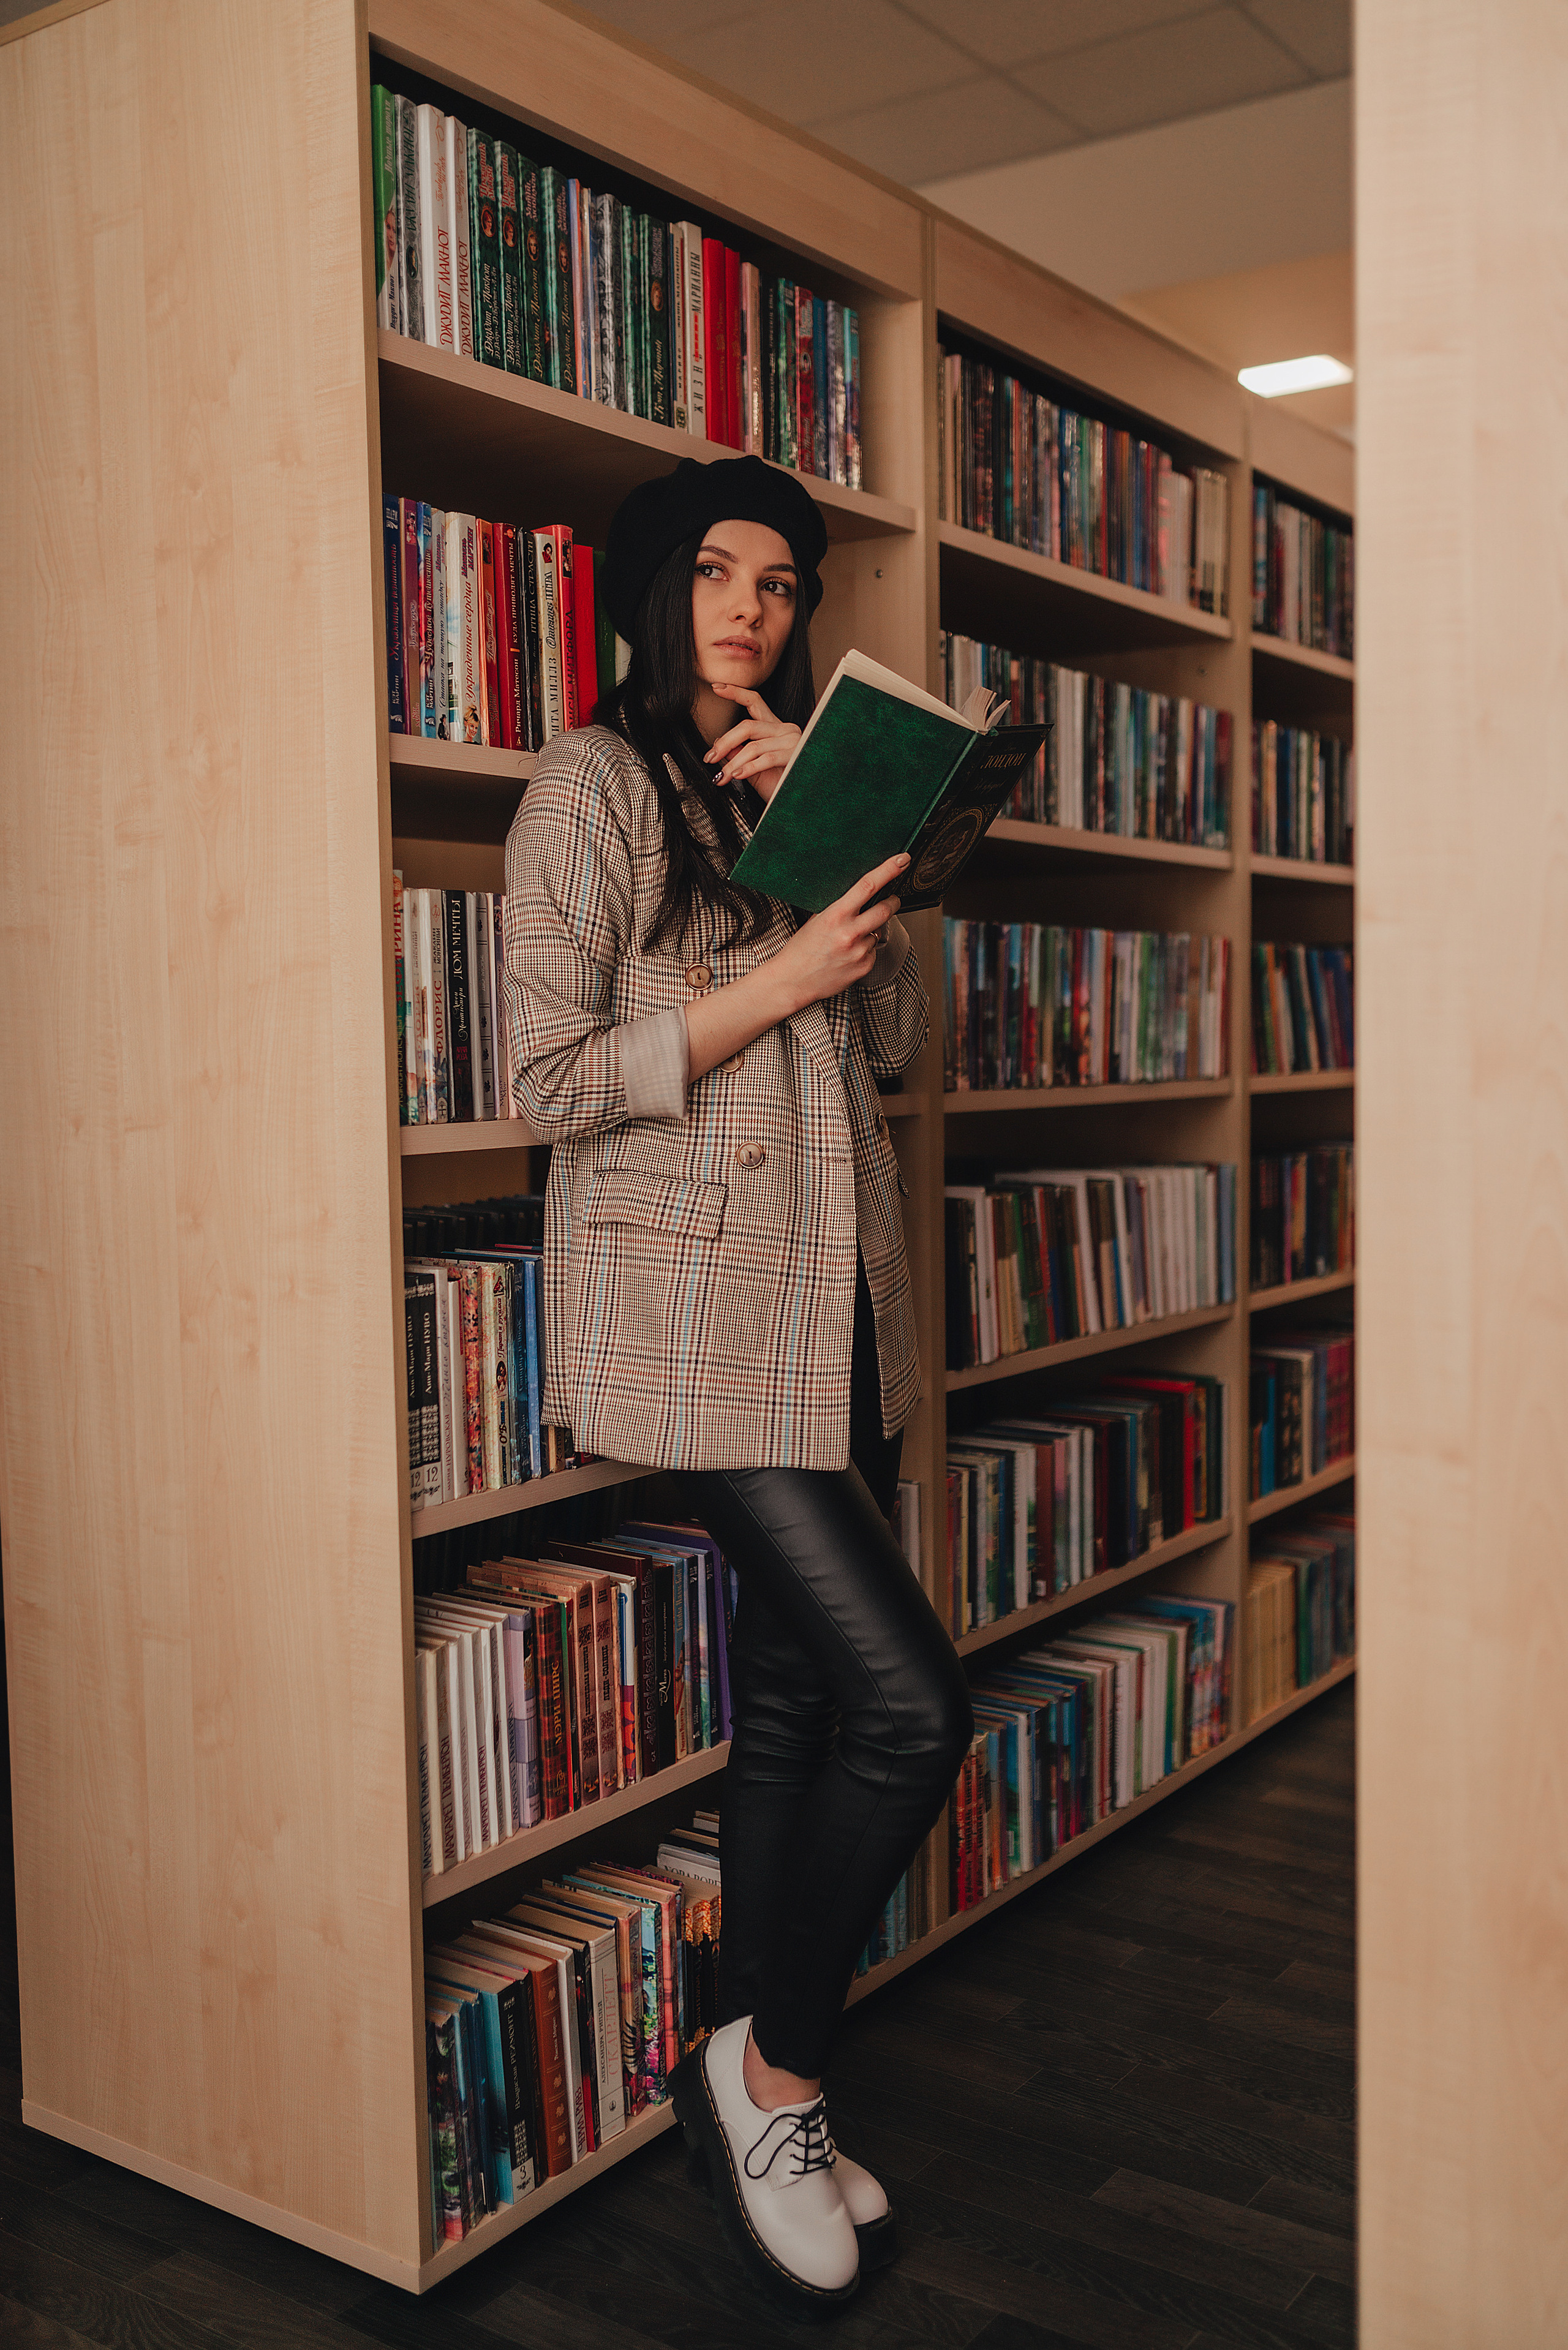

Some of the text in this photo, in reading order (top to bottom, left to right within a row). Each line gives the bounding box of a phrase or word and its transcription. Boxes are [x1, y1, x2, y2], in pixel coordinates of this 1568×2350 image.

[385, 136, 394, 181] Ночные
[478, 142, 489, 197] Праздник
[501, 154, 510, 208] Праздник
[438, 226, 453, 345] ДЖУДИТ МАКНОТ
[458, 238, 472, 355] ДЖУДИТ МАКНОТ
[483, 263, 494, 356] Джудит Макнот
[690, 252, 701, 314] МАРИАННЫ
[505, 273, 515, 365] Джудит Макнот
[531, 268, 543, 378] Джудит Макнот
[561, 280, 574, 388] Джудит Макнот
[654, 339, 665, 420] Кэт Мартин
[424, 550, 434, 662] Чудесное путешествие
[545, 571, 553, 600] ИГРА
[390, 600, 401, 661] Украденная
[440, 657, 445, 668] на
[463, 581, 476, 702] Украденные сердца
[565, 609, 575, 685] МИТФОРД
[548, 658, 558, 702] МИЛЛЗ
[981, 753, 1027, 769] ЛОНДОН
[394, 901, 404, 1007] ЗЕФИРИНА
[451, 899, 462, 979] ДОМ МЕЧТЫ
[434, 980, 443, 1053] ФЛОРИС
[458, 987, 468, 1041] Монтгомери
[411, 1471, 421, 1488] 12
[426, 1467, 439, 1483] 12
[508, 1701, 516, 1763] ПЕМБЕРТОН
[551, 1660, 563, 1745] МЭРИ ПИРС
[441, 1735, 452, 1799] ПЕМБЕРТОН
[460, 1727, 469, 1791] ПЕМБЕРТОН
[420, 1742, 432, 1869] МАРГАРЕТ ПЕМБЕРТОН
[442, 1801, 454, 1859] МАРГАРЕТ
[507, 2014, 516, 2064] РЕЙМОНТ
[604, 1975, 619, 2075] СКАРЛЕТТ
[574, 2087, 586, 2153] ЧЕРИЛ РИВЗ
[519, 2165, 526, 2179] 3
